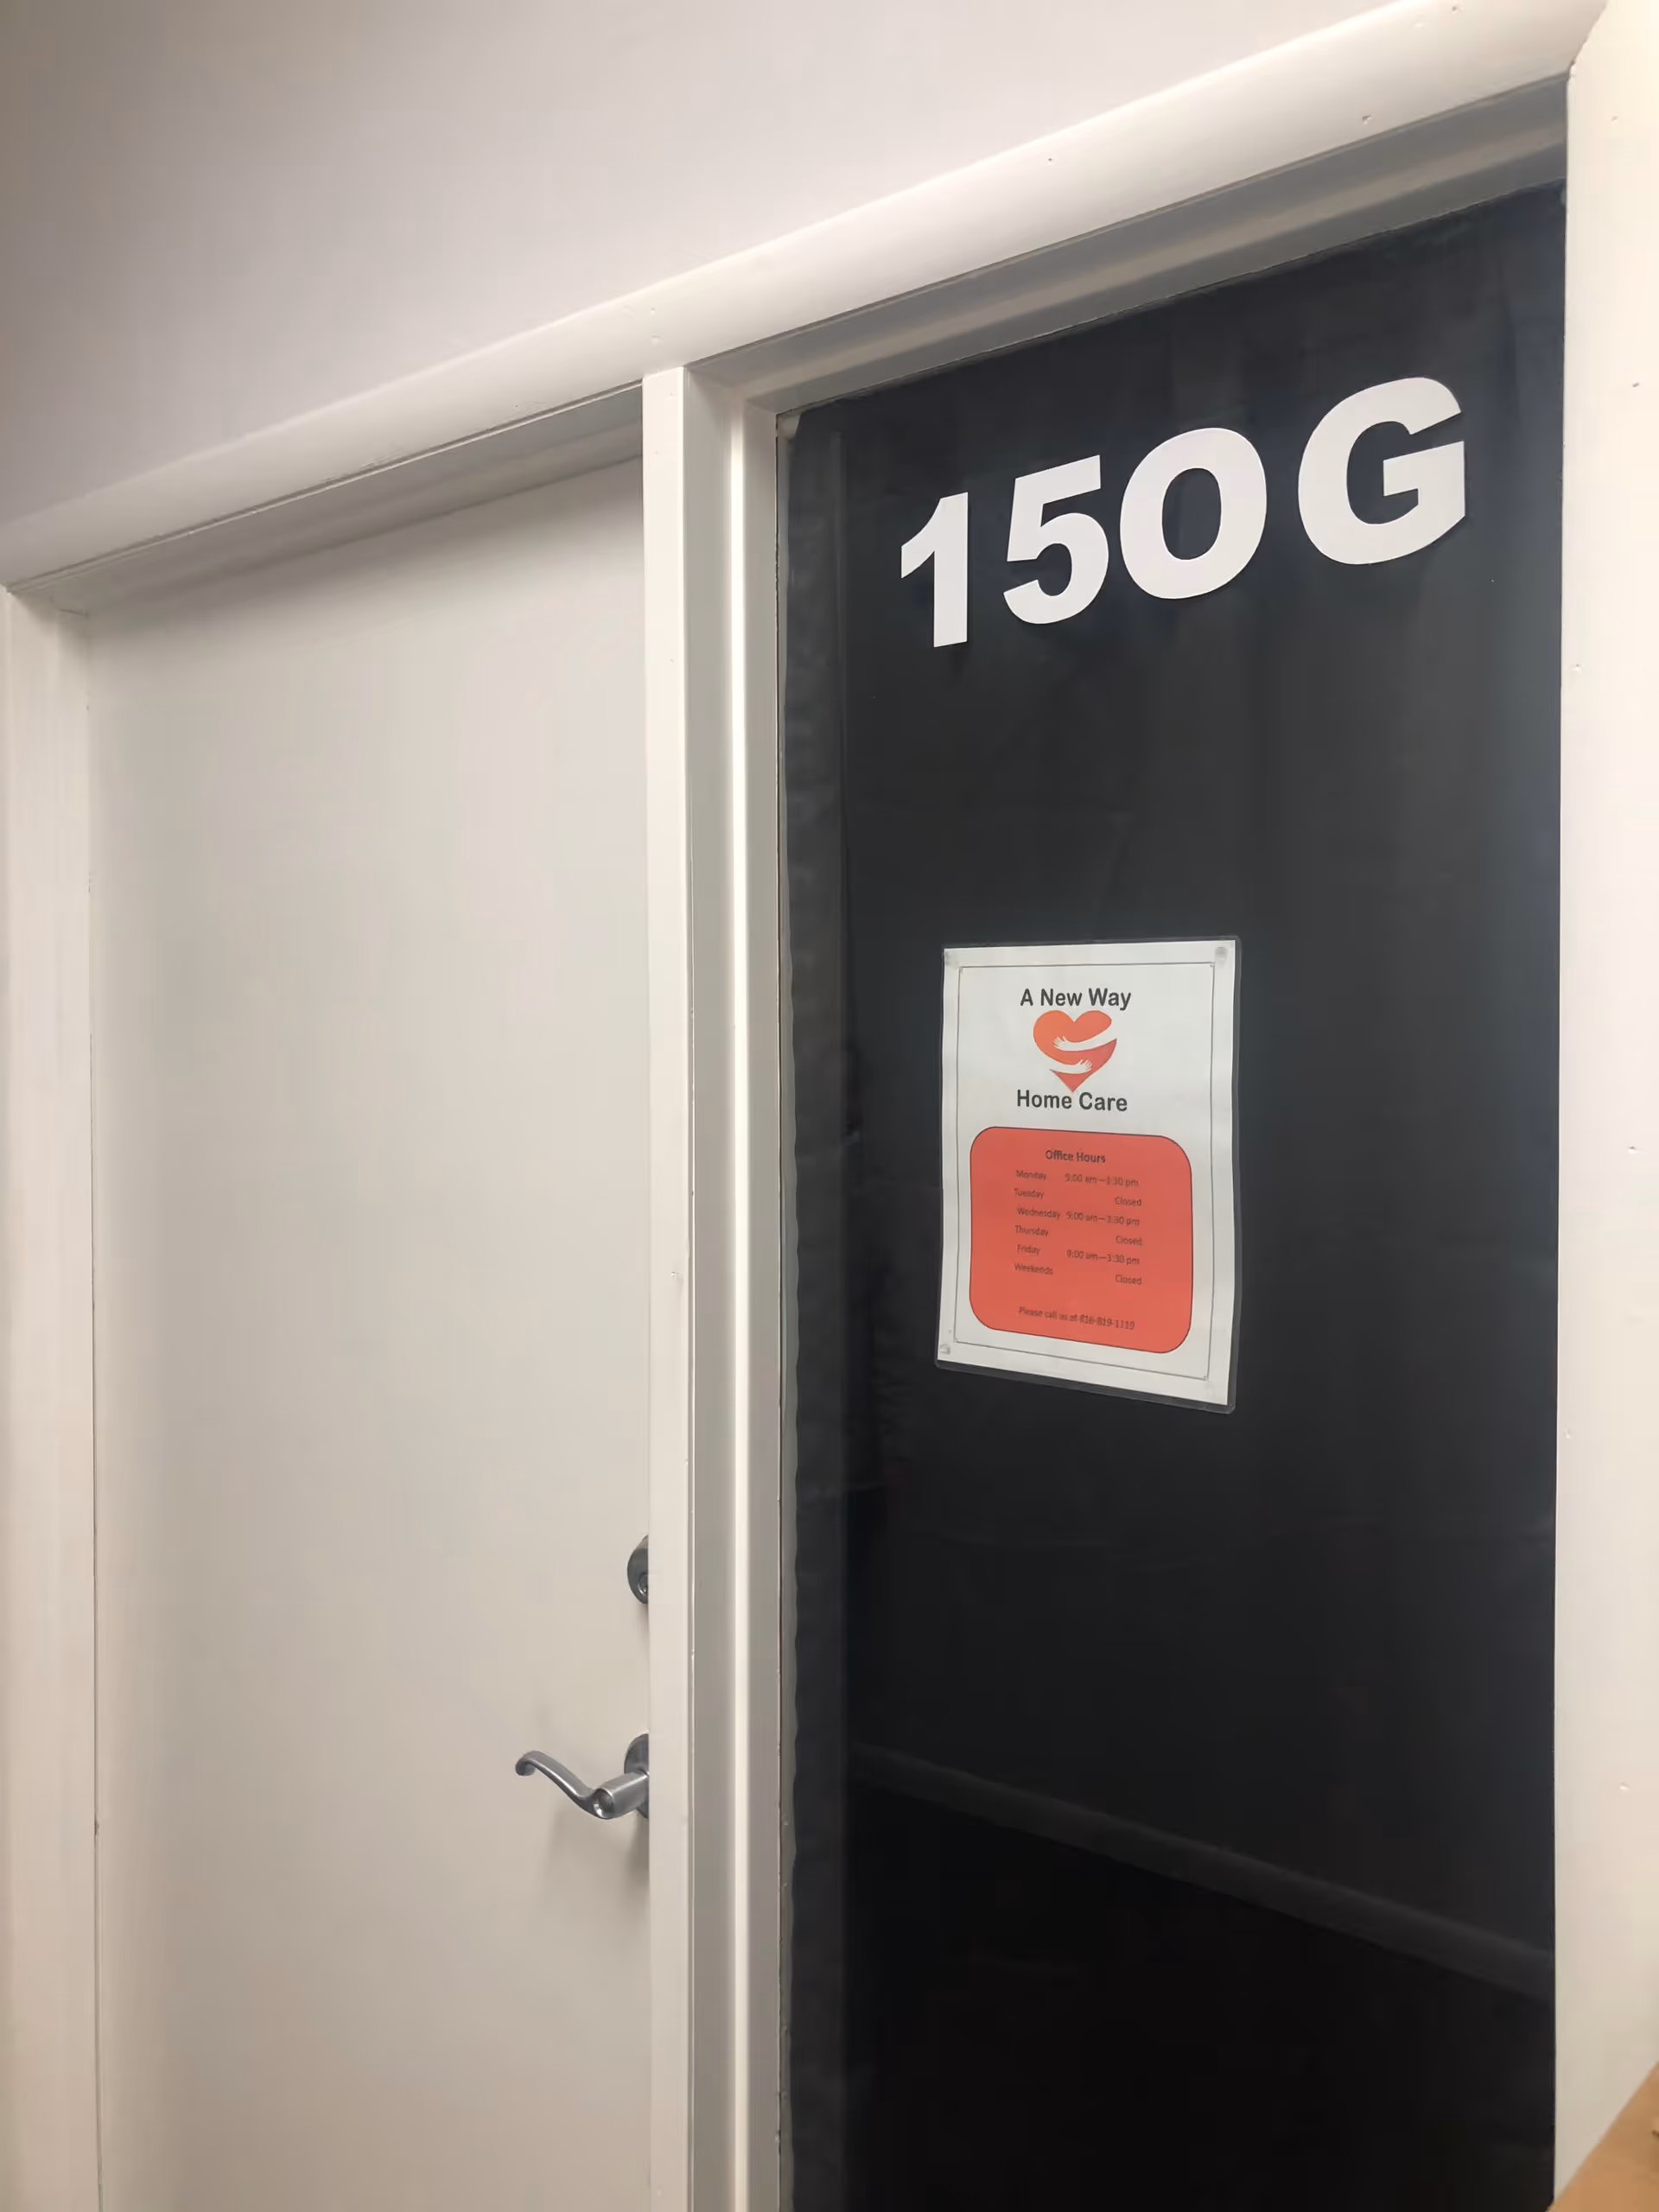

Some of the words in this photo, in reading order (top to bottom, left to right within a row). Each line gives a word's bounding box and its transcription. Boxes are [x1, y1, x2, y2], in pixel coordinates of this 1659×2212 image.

[1020, 988, 1033, 1007] A
[1040, 988, 1083, 1007] New
[1088, 988, 1131, 1011] Way
[1017, 1090, 1072, 1109] Home
[1078, 1091, 1128, 1112] Care
[1046, 1149, 1073, 1161] Office
[1077, 1152, 1106, 1163] Hours
[1015, 1169, 1046, 1181] Monday
[1065, 1173, 1083, 1183] 9:00
[1125, 1179, 1139, 1188] pm
[1014, 1188, 1045, 1199] Tuesday
[1115, 1196, 1142, 1207] Closed
[1017, 1207, 1060, 1220] Wednesday
[1065, 1211, 1084, 1221] 9:00
[1126, 1217, 1140, 1226] pm
[1014, 1224, 1049, 1237] Thursday
[1116, 1235, 1142, 1246] Closed
[1016, 1244, 1040, 1255] Friday
[1126, 1255, 1140, 1265] pm
[1014, 1262, 1053, 1274] Weekends
[1115, 1274, 1142, 1285] Closed
[1019, 1306, 1043, 1318] Please
[1045, 1311, 1057, 1319] call
[1070, 1313, 1077, 1322] at
